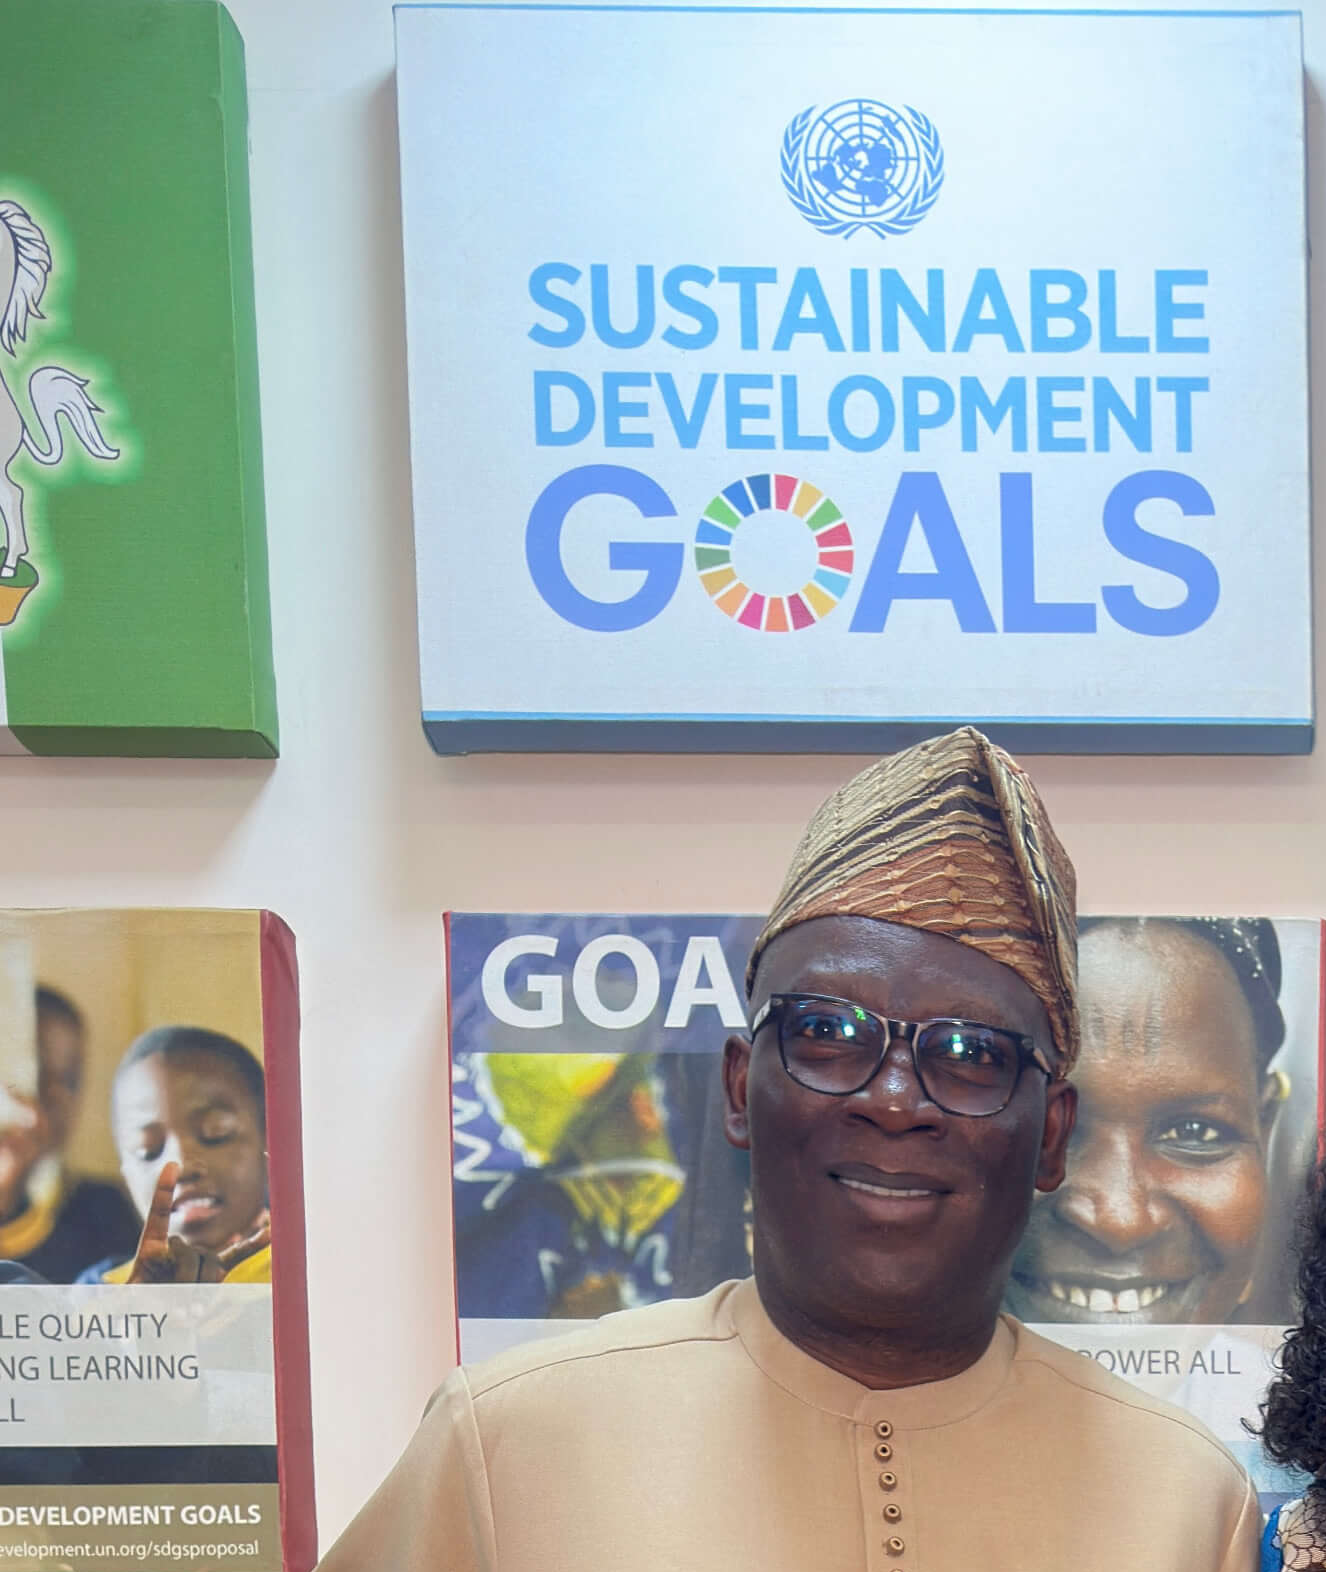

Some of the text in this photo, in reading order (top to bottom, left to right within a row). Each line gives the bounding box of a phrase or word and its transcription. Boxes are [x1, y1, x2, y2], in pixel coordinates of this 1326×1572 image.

[527, 261, 1210, 353] SUSTAINABLE
[533, 370, 1210, 453] DEVELOPMENT
[525, 464, 1221, 637] GOALS
[39, 1313, 168, 1341] QUALITY
[50, 1355, 199, 1381] LEARNING
[1190, 1350, 1241, 1375] ALL
[0, 1504, 262, 1526] DEVELOPMENT GOALS
